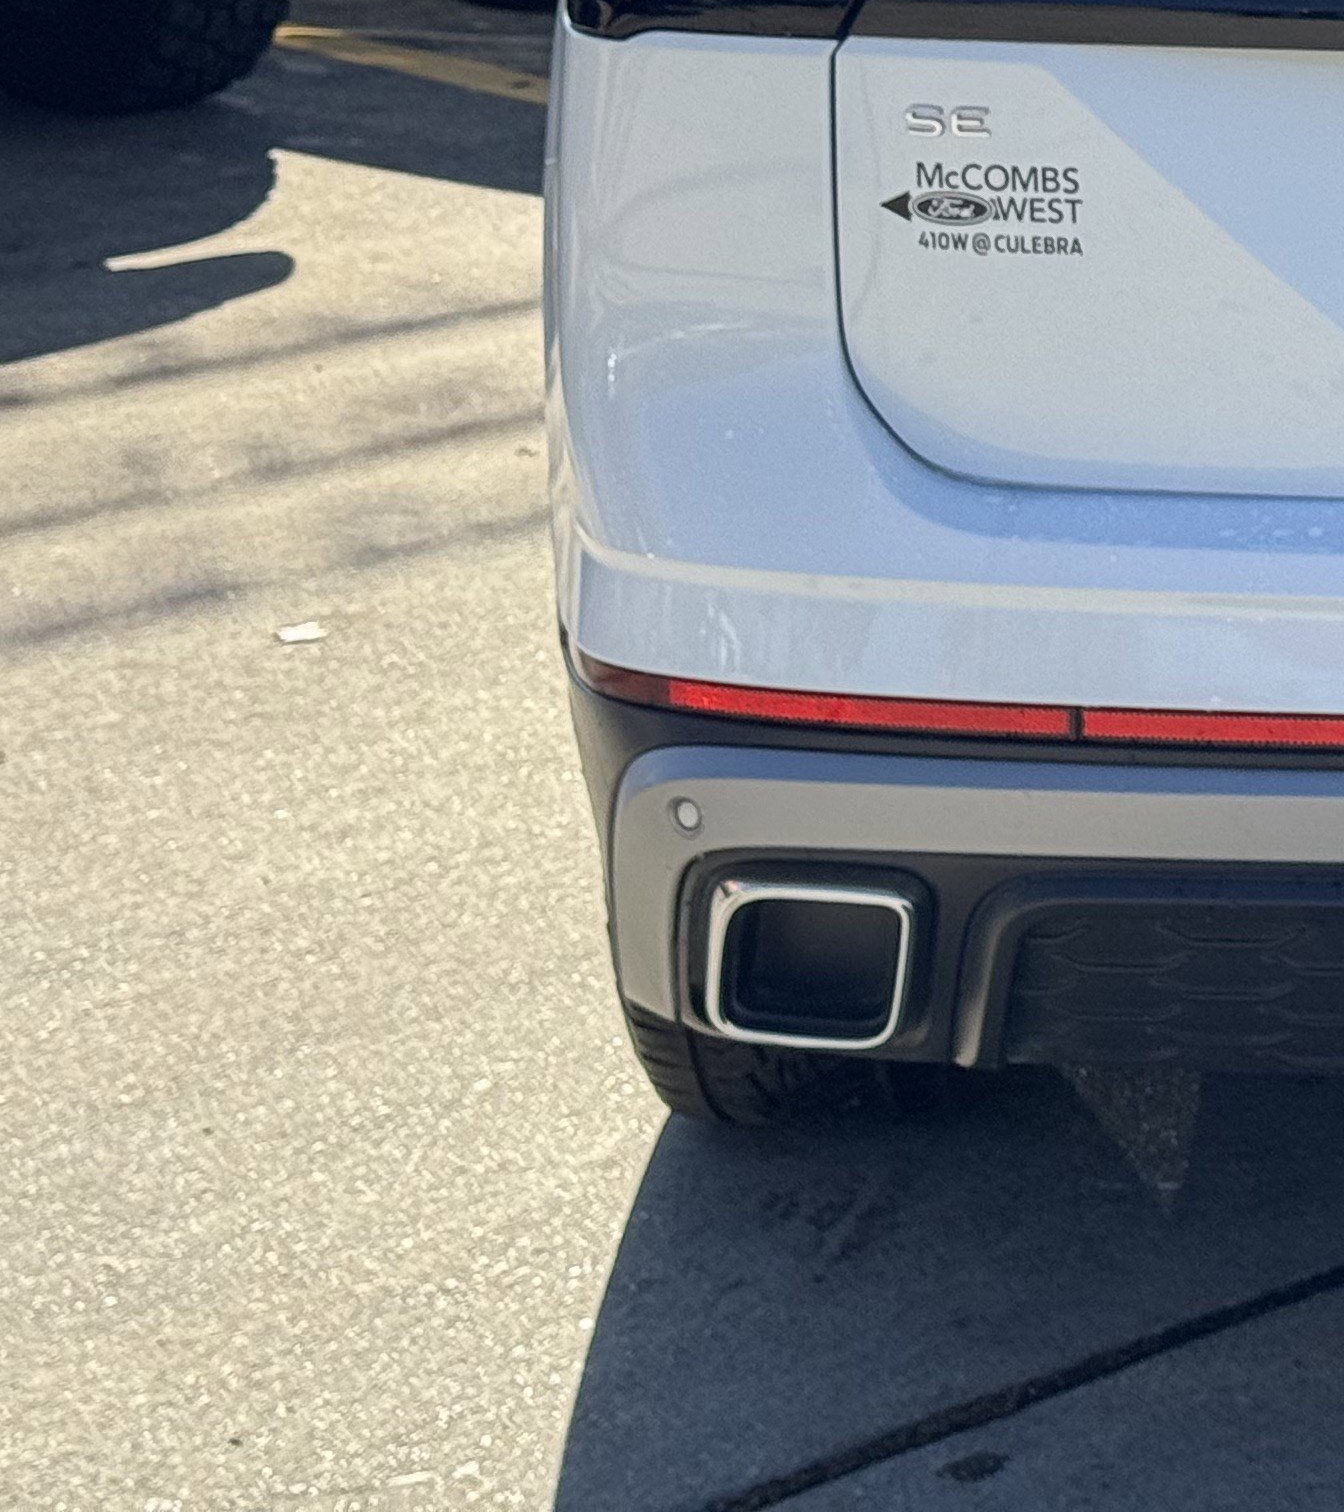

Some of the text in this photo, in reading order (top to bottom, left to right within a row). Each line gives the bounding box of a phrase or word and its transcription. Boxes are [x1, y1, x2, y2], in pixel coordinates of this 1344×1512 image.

[904, 102, 993, 139] SE
[915, 161, 1080, 195] McCOMBS
[996, 196, 1084, 224] WEST
